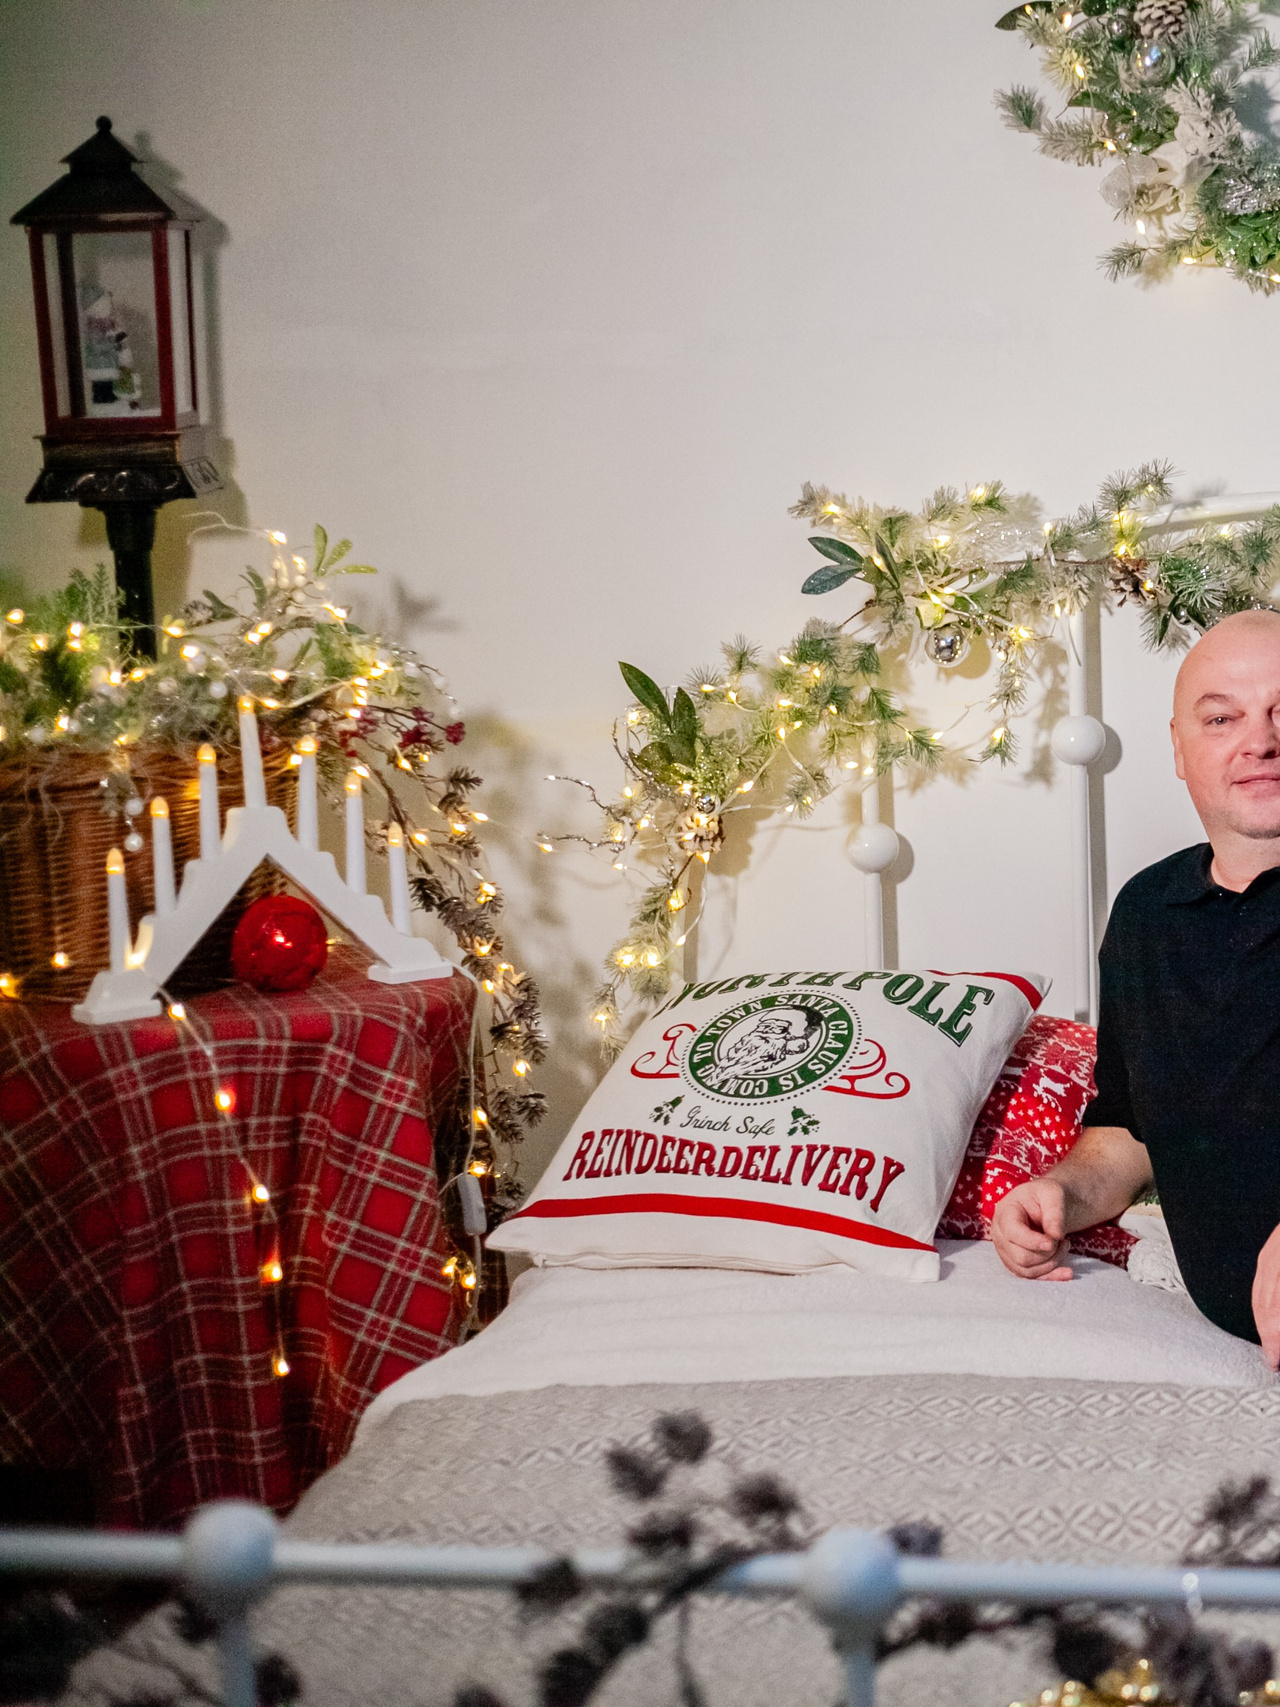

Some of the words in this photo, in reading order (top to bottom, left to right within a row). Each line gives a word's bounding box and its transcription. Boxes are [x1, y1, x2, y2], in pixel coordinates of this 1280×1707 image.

[706, 1001, 763, 1039] TOWN
[775, 994, 840, 1018] SANTA
[842, 971, 995, 1047] POLE
[692, 1041, 715, 1063] TO
[807, 1020, 848, 1075] CLAUS
[779, 1071, 805, 1091] IS
[680, 1105, 732, 1132] Grinch
[735, 1115, 776, 1139] Safe
